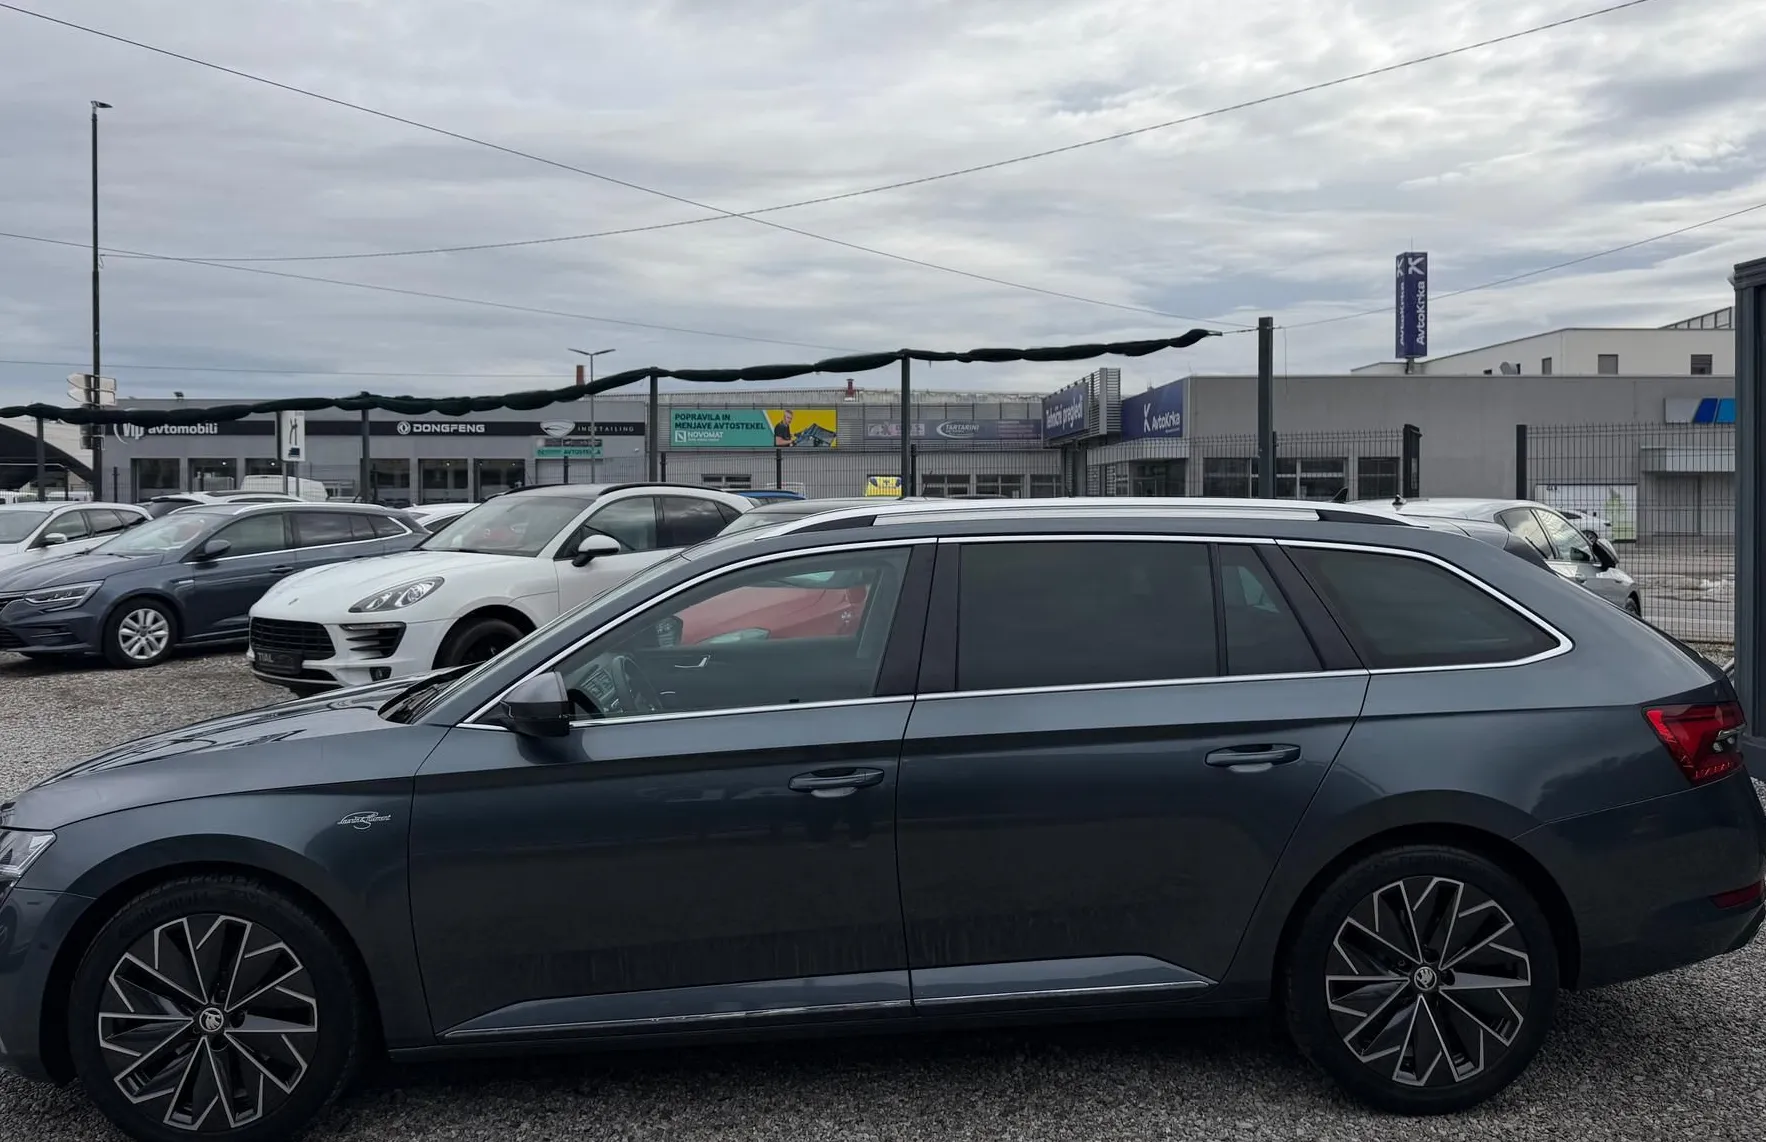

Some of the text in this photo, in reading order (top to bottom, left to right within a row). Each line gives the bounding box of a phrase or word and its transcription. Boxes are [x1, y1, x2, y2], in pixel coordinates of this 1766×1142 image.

[1416, 281, 1426, 345] AvtoKrka
[675, 413, 720, 421] POPRAVILA
[1152, 411, 1180, 431] AvtoKrka
[148, 423, 218, 434] avtomobili
[413, 424, 485, 433] DONGFENG
[714, 422, 766, 430] AVTOSTEKEL
[946, 424, 979, 432] TARTARINI
